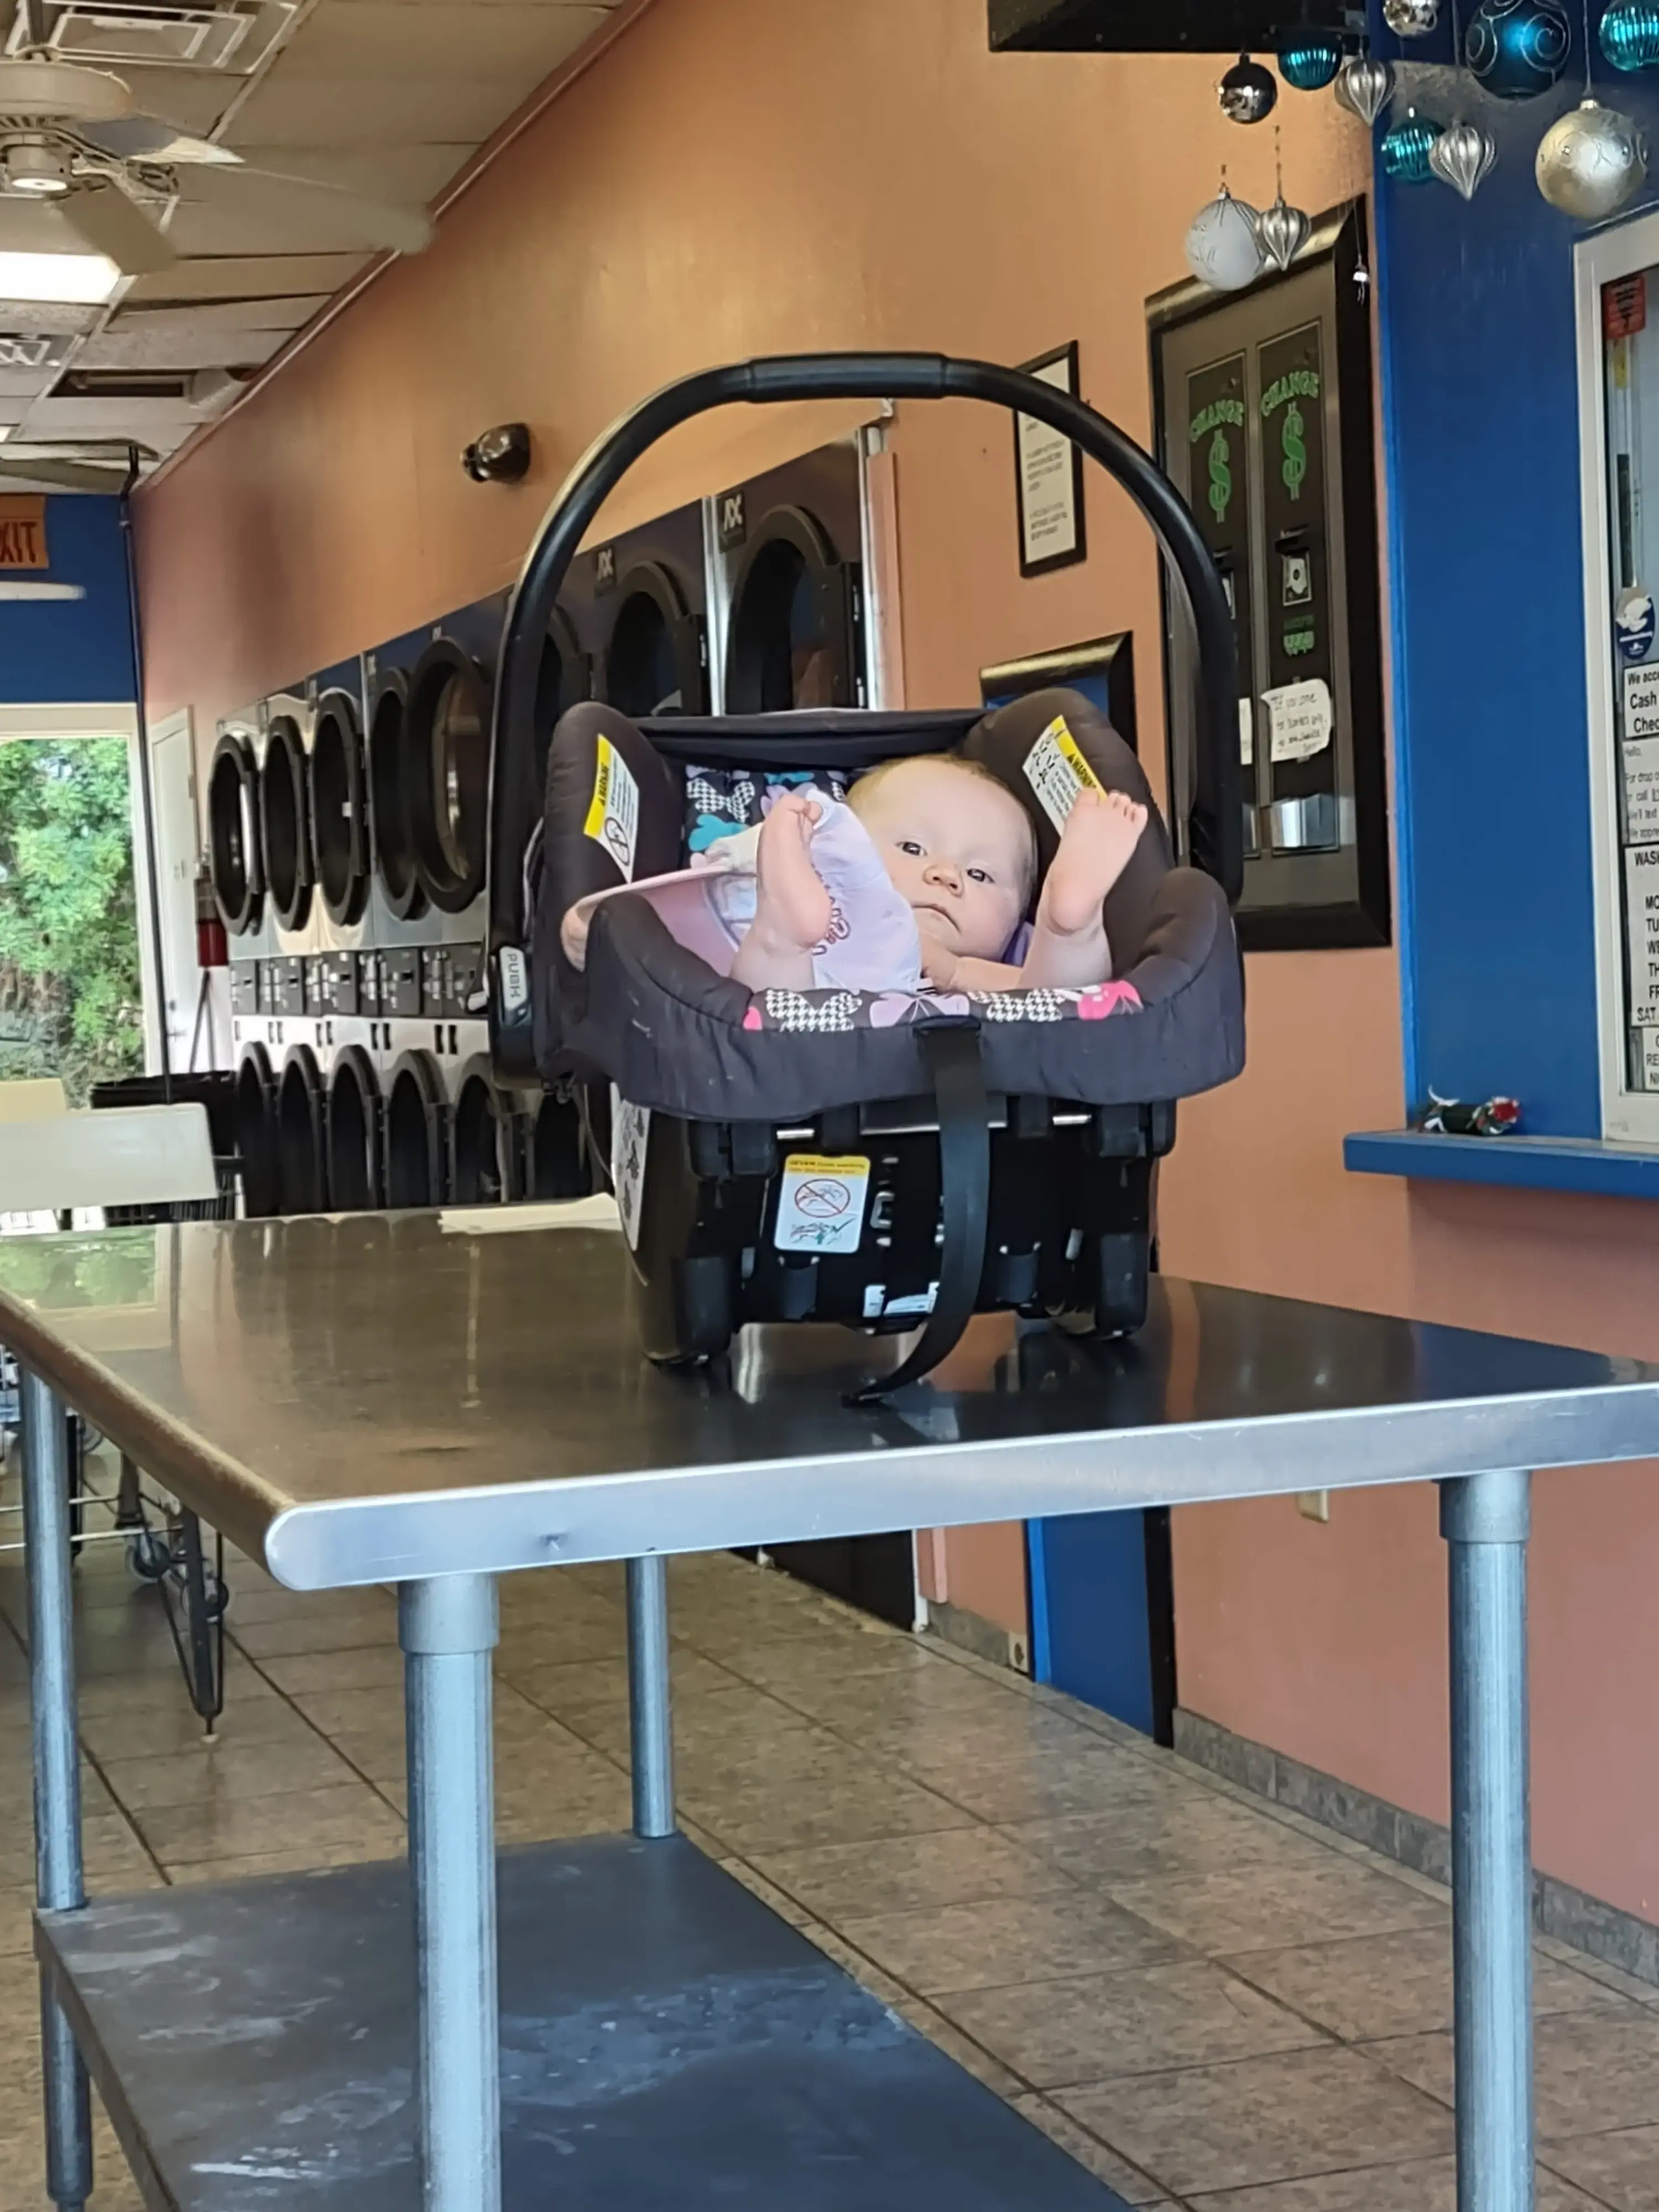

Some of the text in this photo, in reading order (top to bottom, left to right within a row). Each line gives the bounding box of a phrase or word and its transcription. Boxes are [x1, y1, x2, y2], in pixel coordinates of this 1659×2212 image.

[1261, 370, 1319, 417] CHANGE
[1189, 399, 1244, 443] CHANGE
[1627, 673, 1641, 686] We
[1630, 691, 1657, 709] Cash
[1637, 1006, 1656, 1022] SAT
